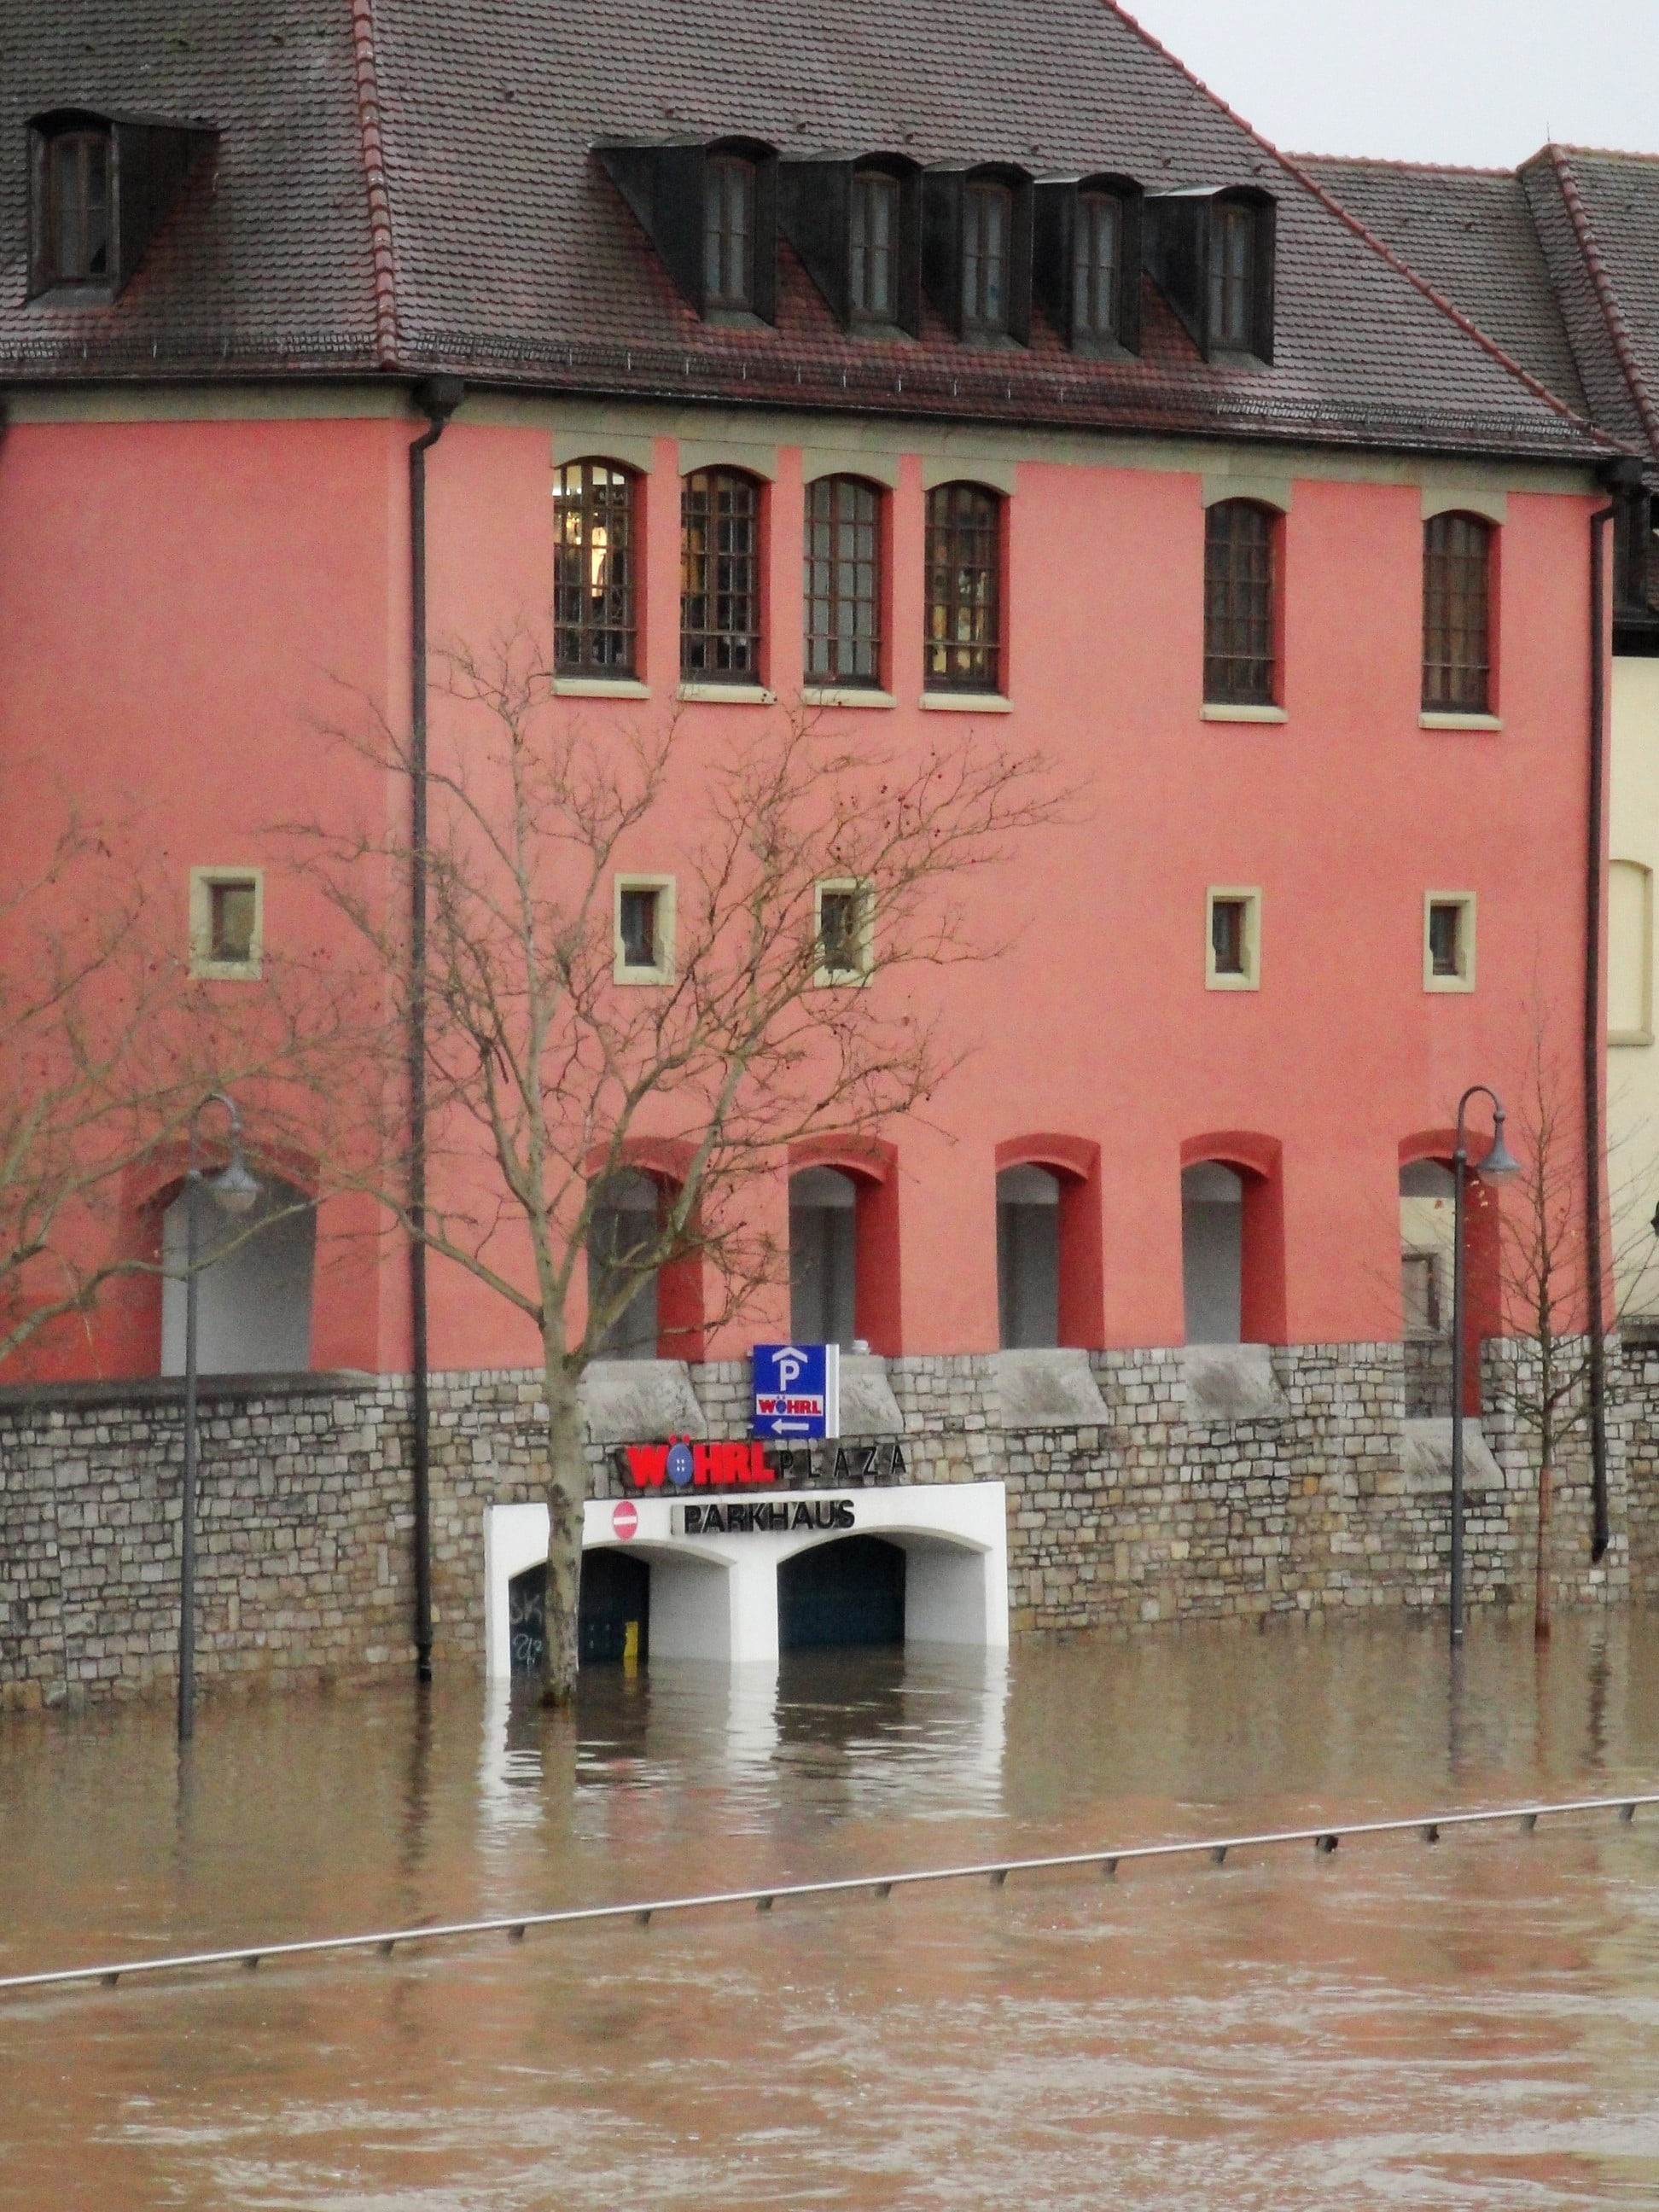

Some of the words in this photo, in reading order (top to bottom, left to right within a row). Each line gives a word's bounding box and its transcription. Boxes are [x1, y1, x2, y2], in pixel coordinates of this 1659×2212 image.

[780, 1359, 800, 1391] P
[758, 1395, 822, 1414] WÖHRL
[627, 1435, 775, 1486] WÖHRL
[780, 1445, 908, 1477] PLAZA
[684, 1499, 855, 1534] PARKHAUS
